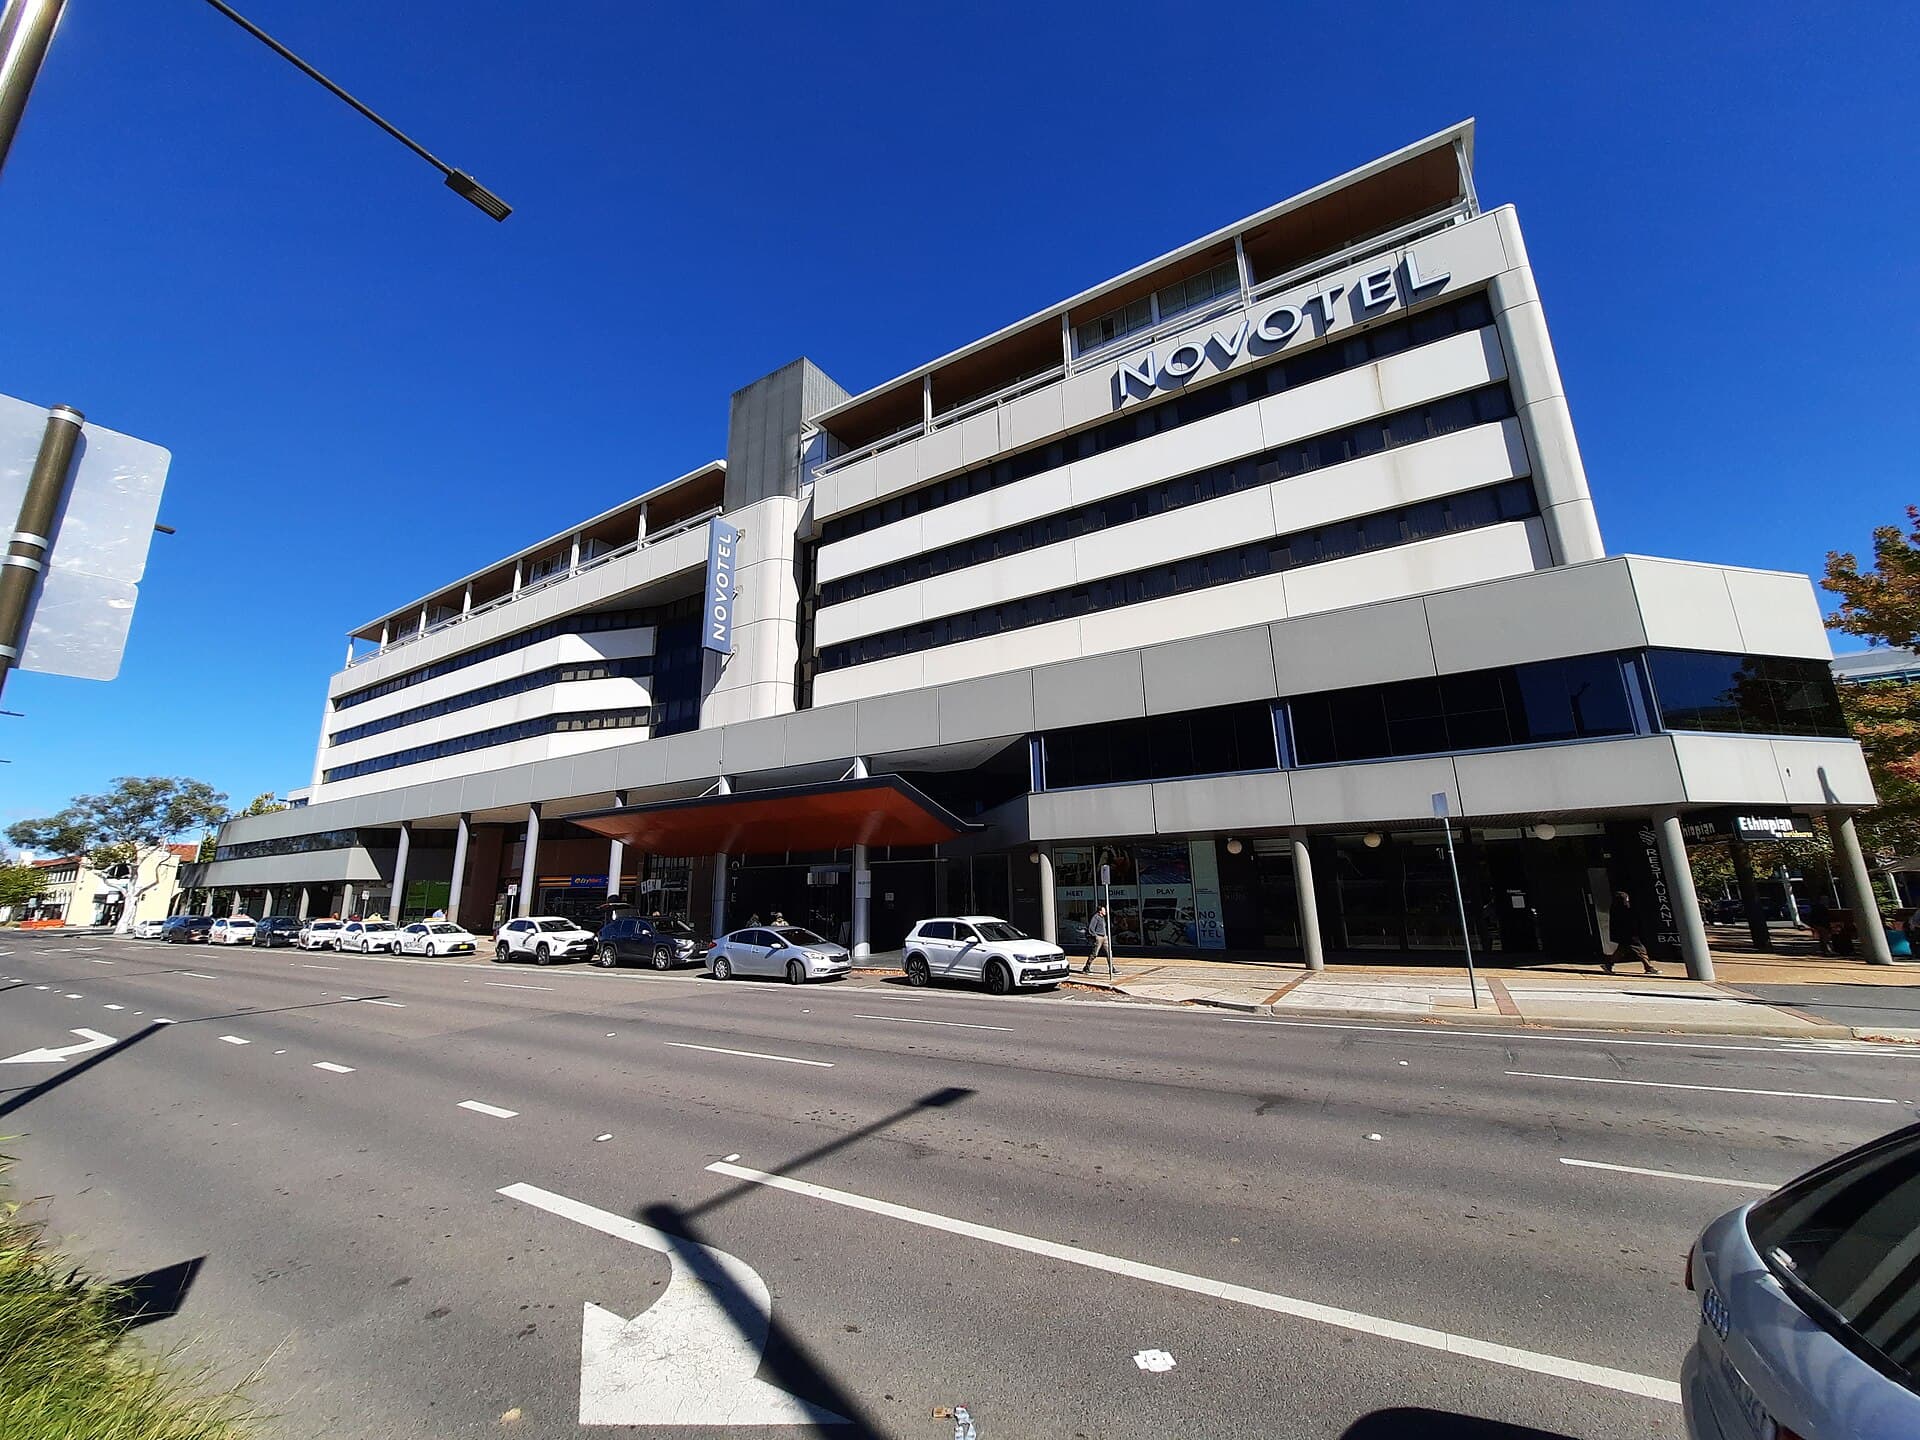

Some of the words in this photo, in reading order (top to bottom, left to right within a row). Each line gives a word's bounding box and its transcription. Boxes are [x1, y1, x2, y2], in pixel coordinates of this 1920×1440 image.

[1117, 250, 1451, 399] NOVOTEL
[712, 533, 732, 641] NOVOTEL
[1739, 815, 1793, 834] Ethiopian
[1646, 848, 1673, 928] RESTAURANT
